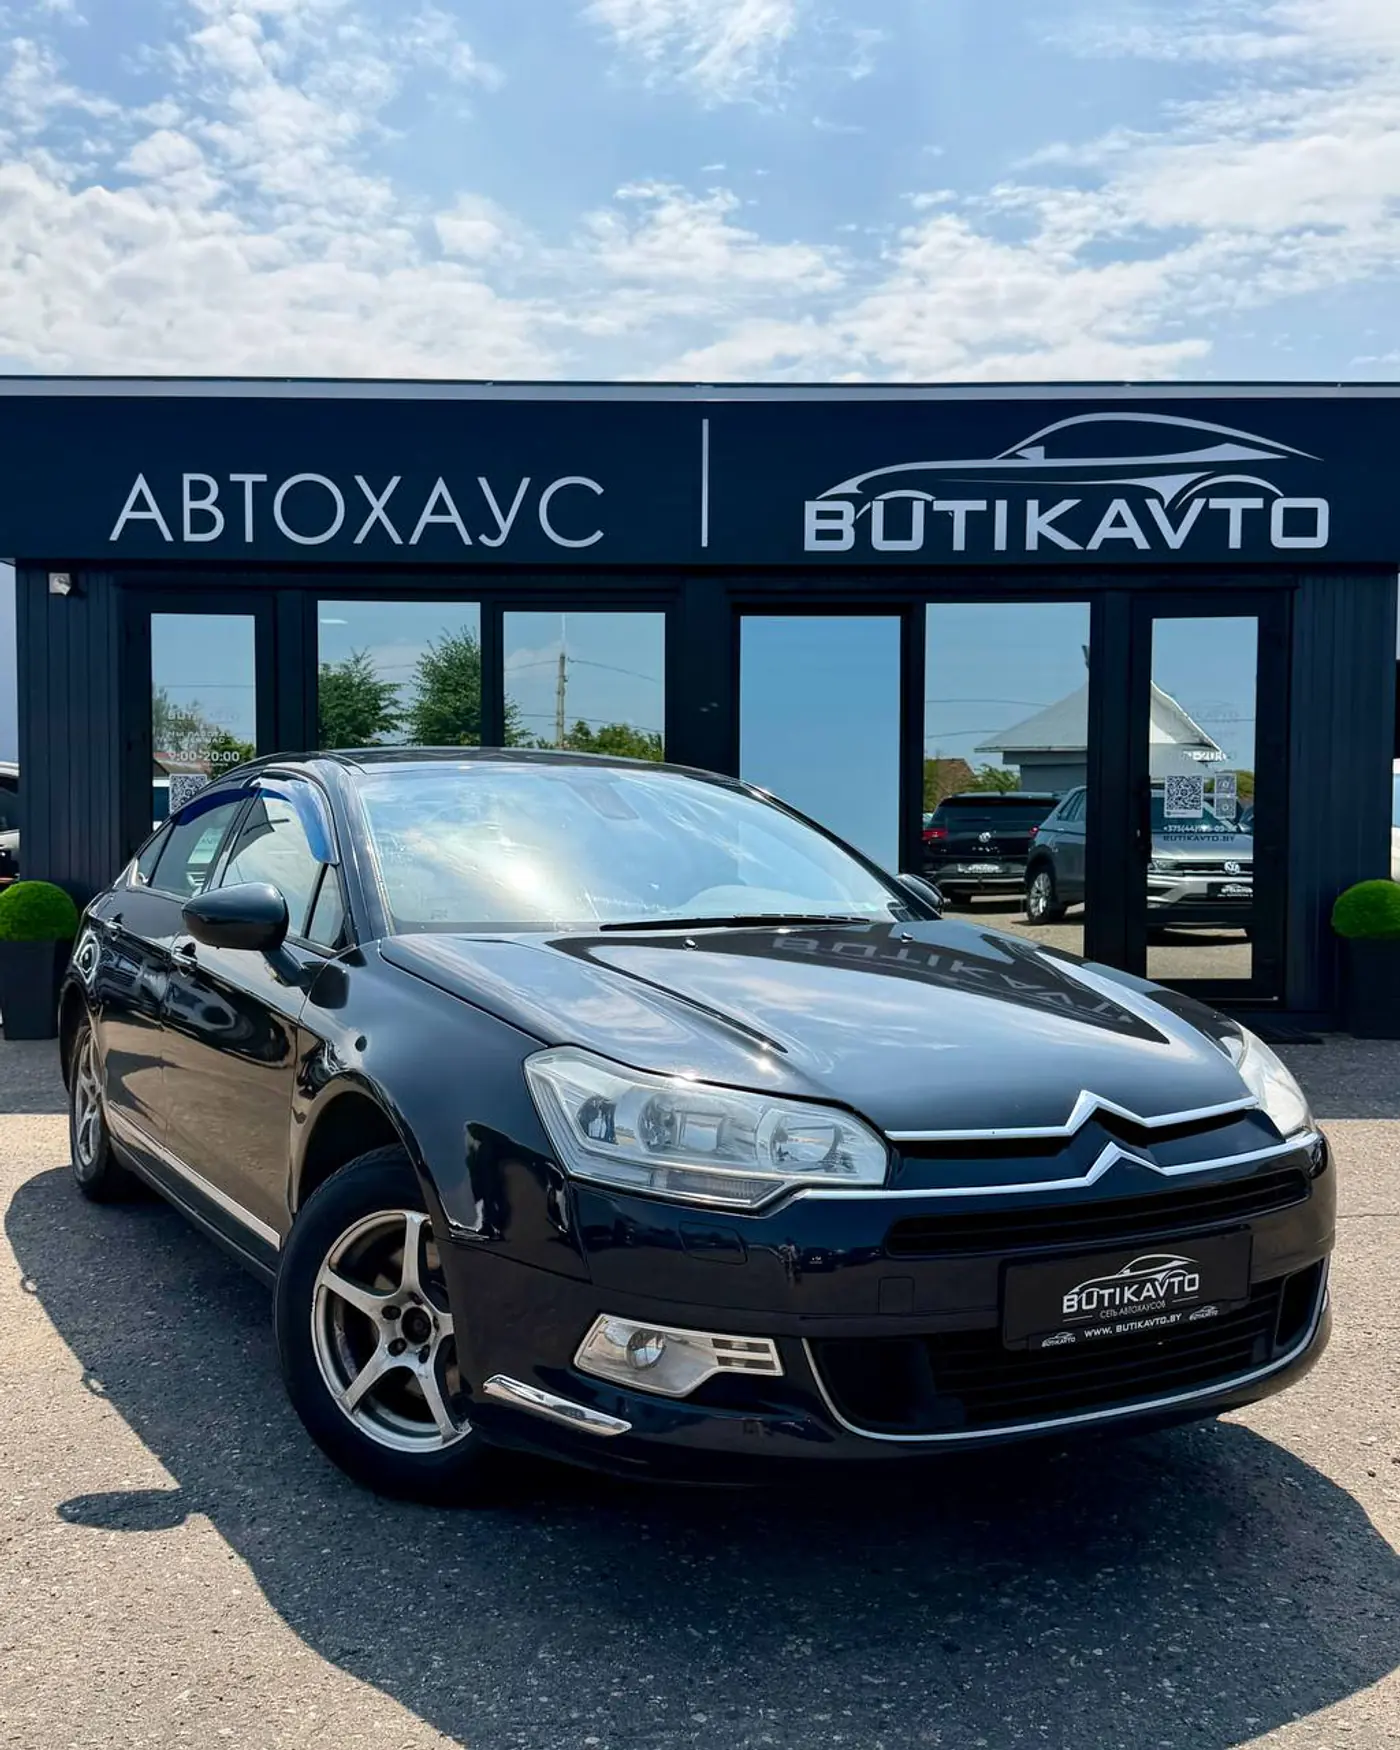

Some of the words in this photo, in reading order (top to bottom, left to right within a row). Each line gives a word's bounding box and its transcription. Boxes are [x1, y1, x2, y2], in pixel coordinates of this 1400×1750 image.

[109, 473, 604, 547] АВТОХАУС
[804, 497, 1329, 551] BUTIKAVTO
[1063, 1273, 1199, 1313] BUTIKAVTO
